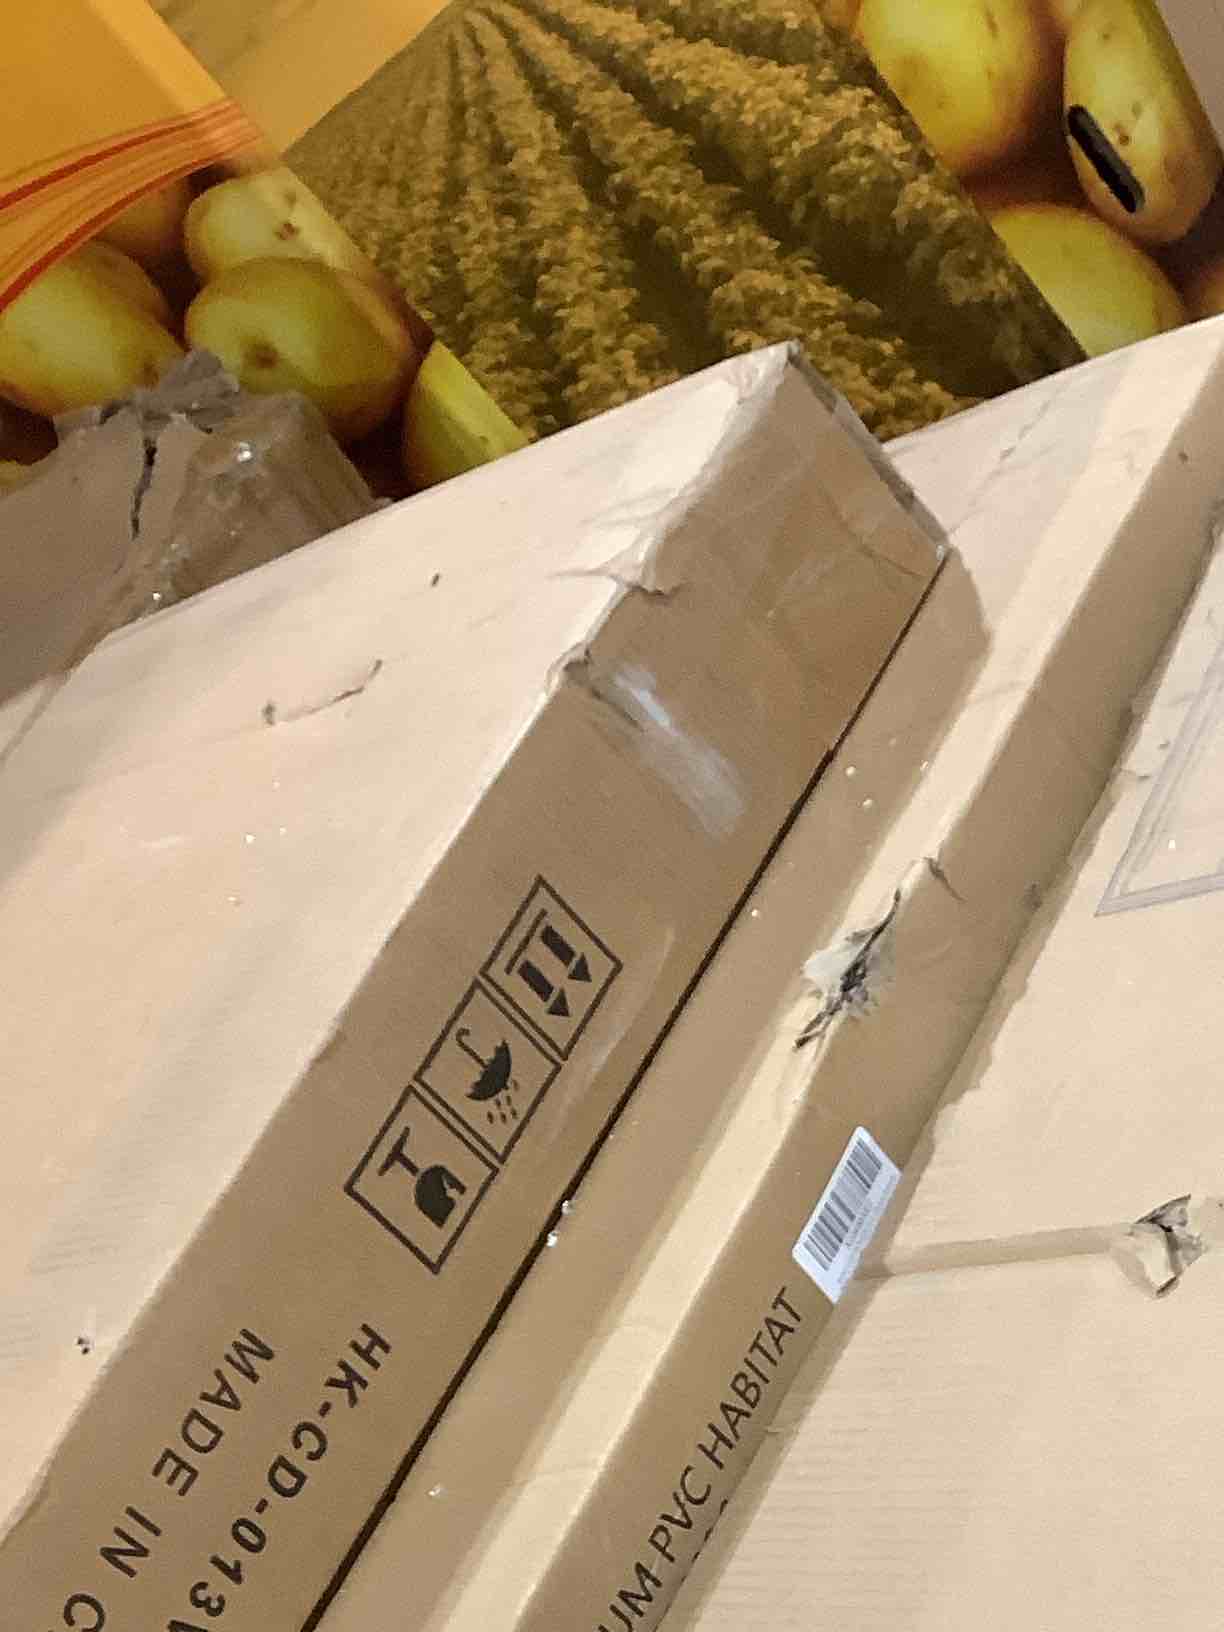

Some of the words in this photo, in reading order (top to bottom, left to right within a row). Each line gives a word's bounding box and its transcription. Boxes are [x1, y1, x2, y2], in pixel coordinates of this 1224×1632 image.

[151, 1328, 275, 1496] MADE
[649, 1465, 712, 1563] PVC
[697, 1287, 804, 1471] HABITAT
[100, 1505, 162, 1578] IN
